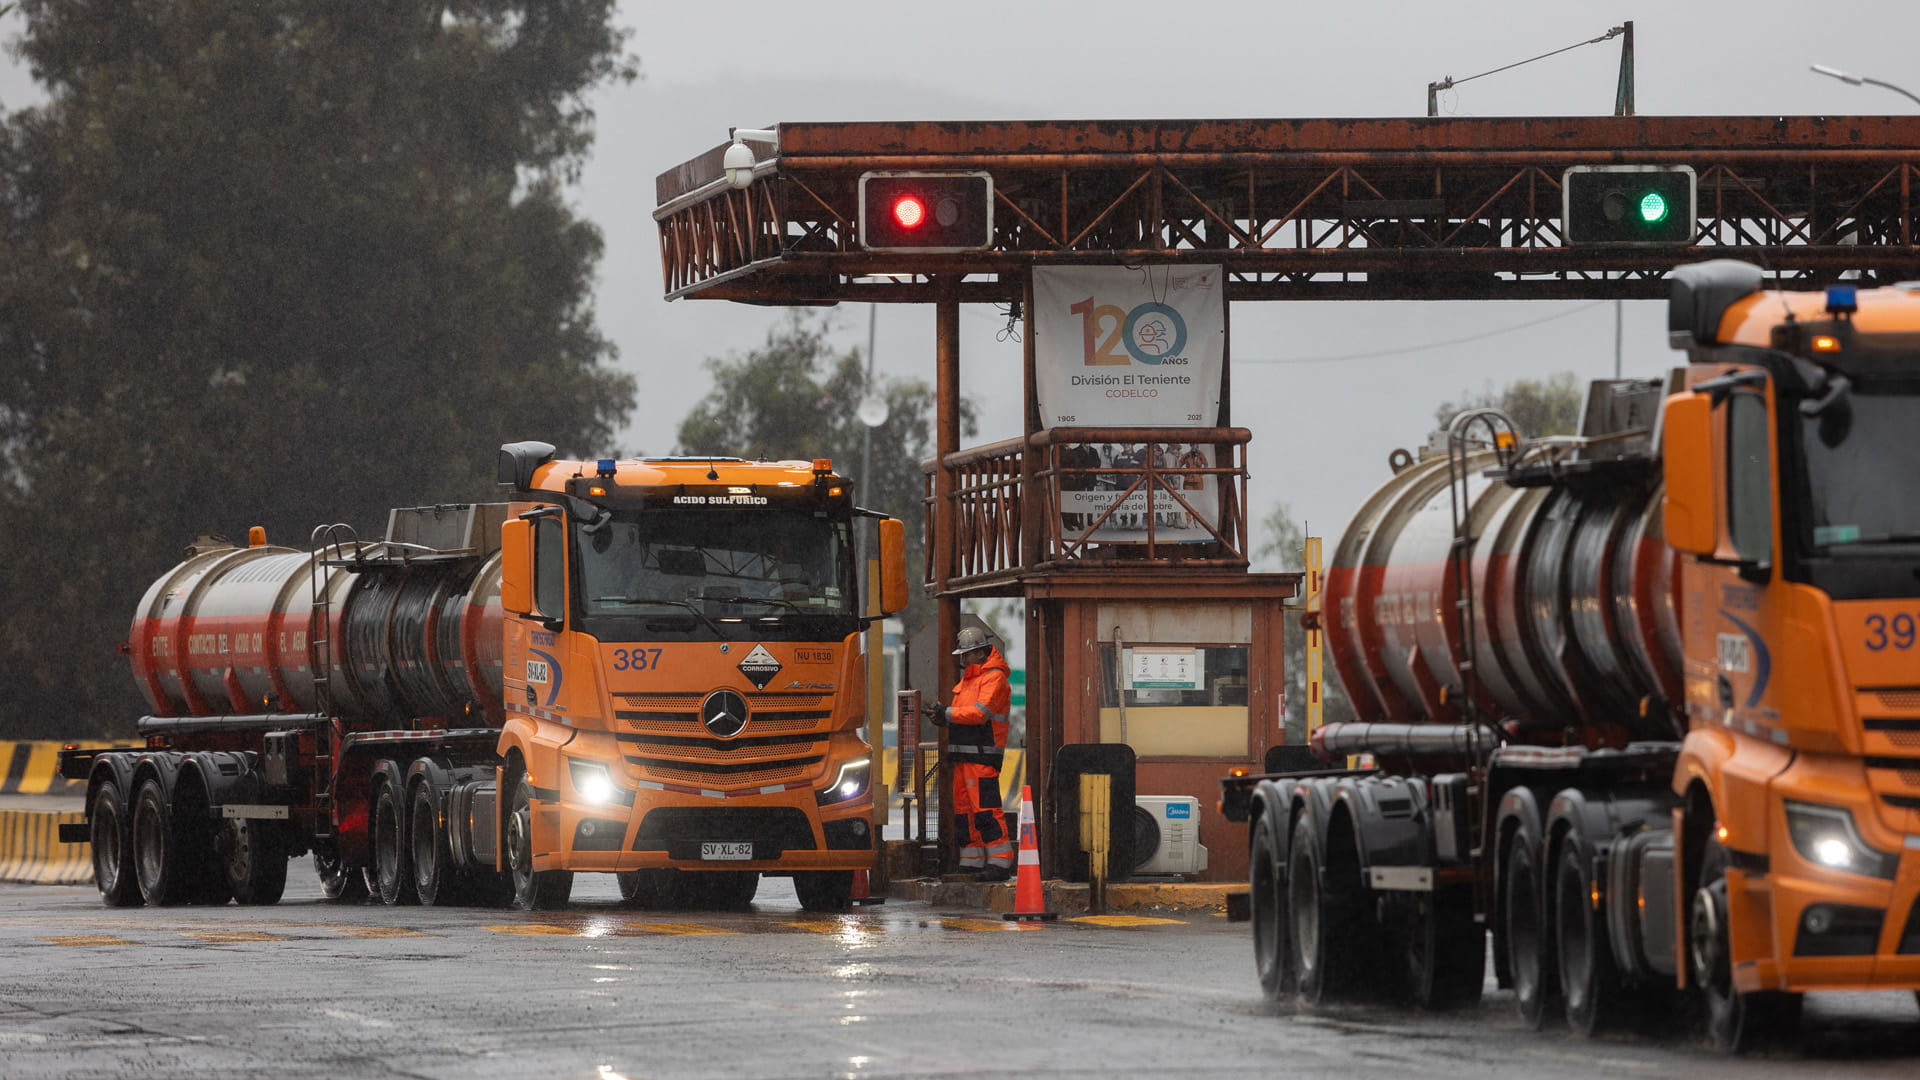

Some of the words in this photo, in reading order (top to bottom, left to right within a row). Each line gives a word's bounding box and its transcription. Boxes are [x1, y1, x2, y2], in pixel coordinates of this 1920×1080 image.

[1071, 296, 1187, 366] 120
[1162, 357, 1188, 366] AÑOS
[1071, 375, 1120, 386] División
[1123, 375, 1134, 385] El
[1137, 374, 1191, 385] Teniente
[1105, 389, 1158, 398] CODELCO
[673, 496, 706, 504] ACIDO
[708, 496, 768, 505] SULFURICO
[1074, 493, 1104, 502] Origen
[1107, 494, 1113, 502] y
[1131, 502, 1146, 511] del
[1865, 613, 1920, 651] 39
[613, 648, 663, 671] 387
